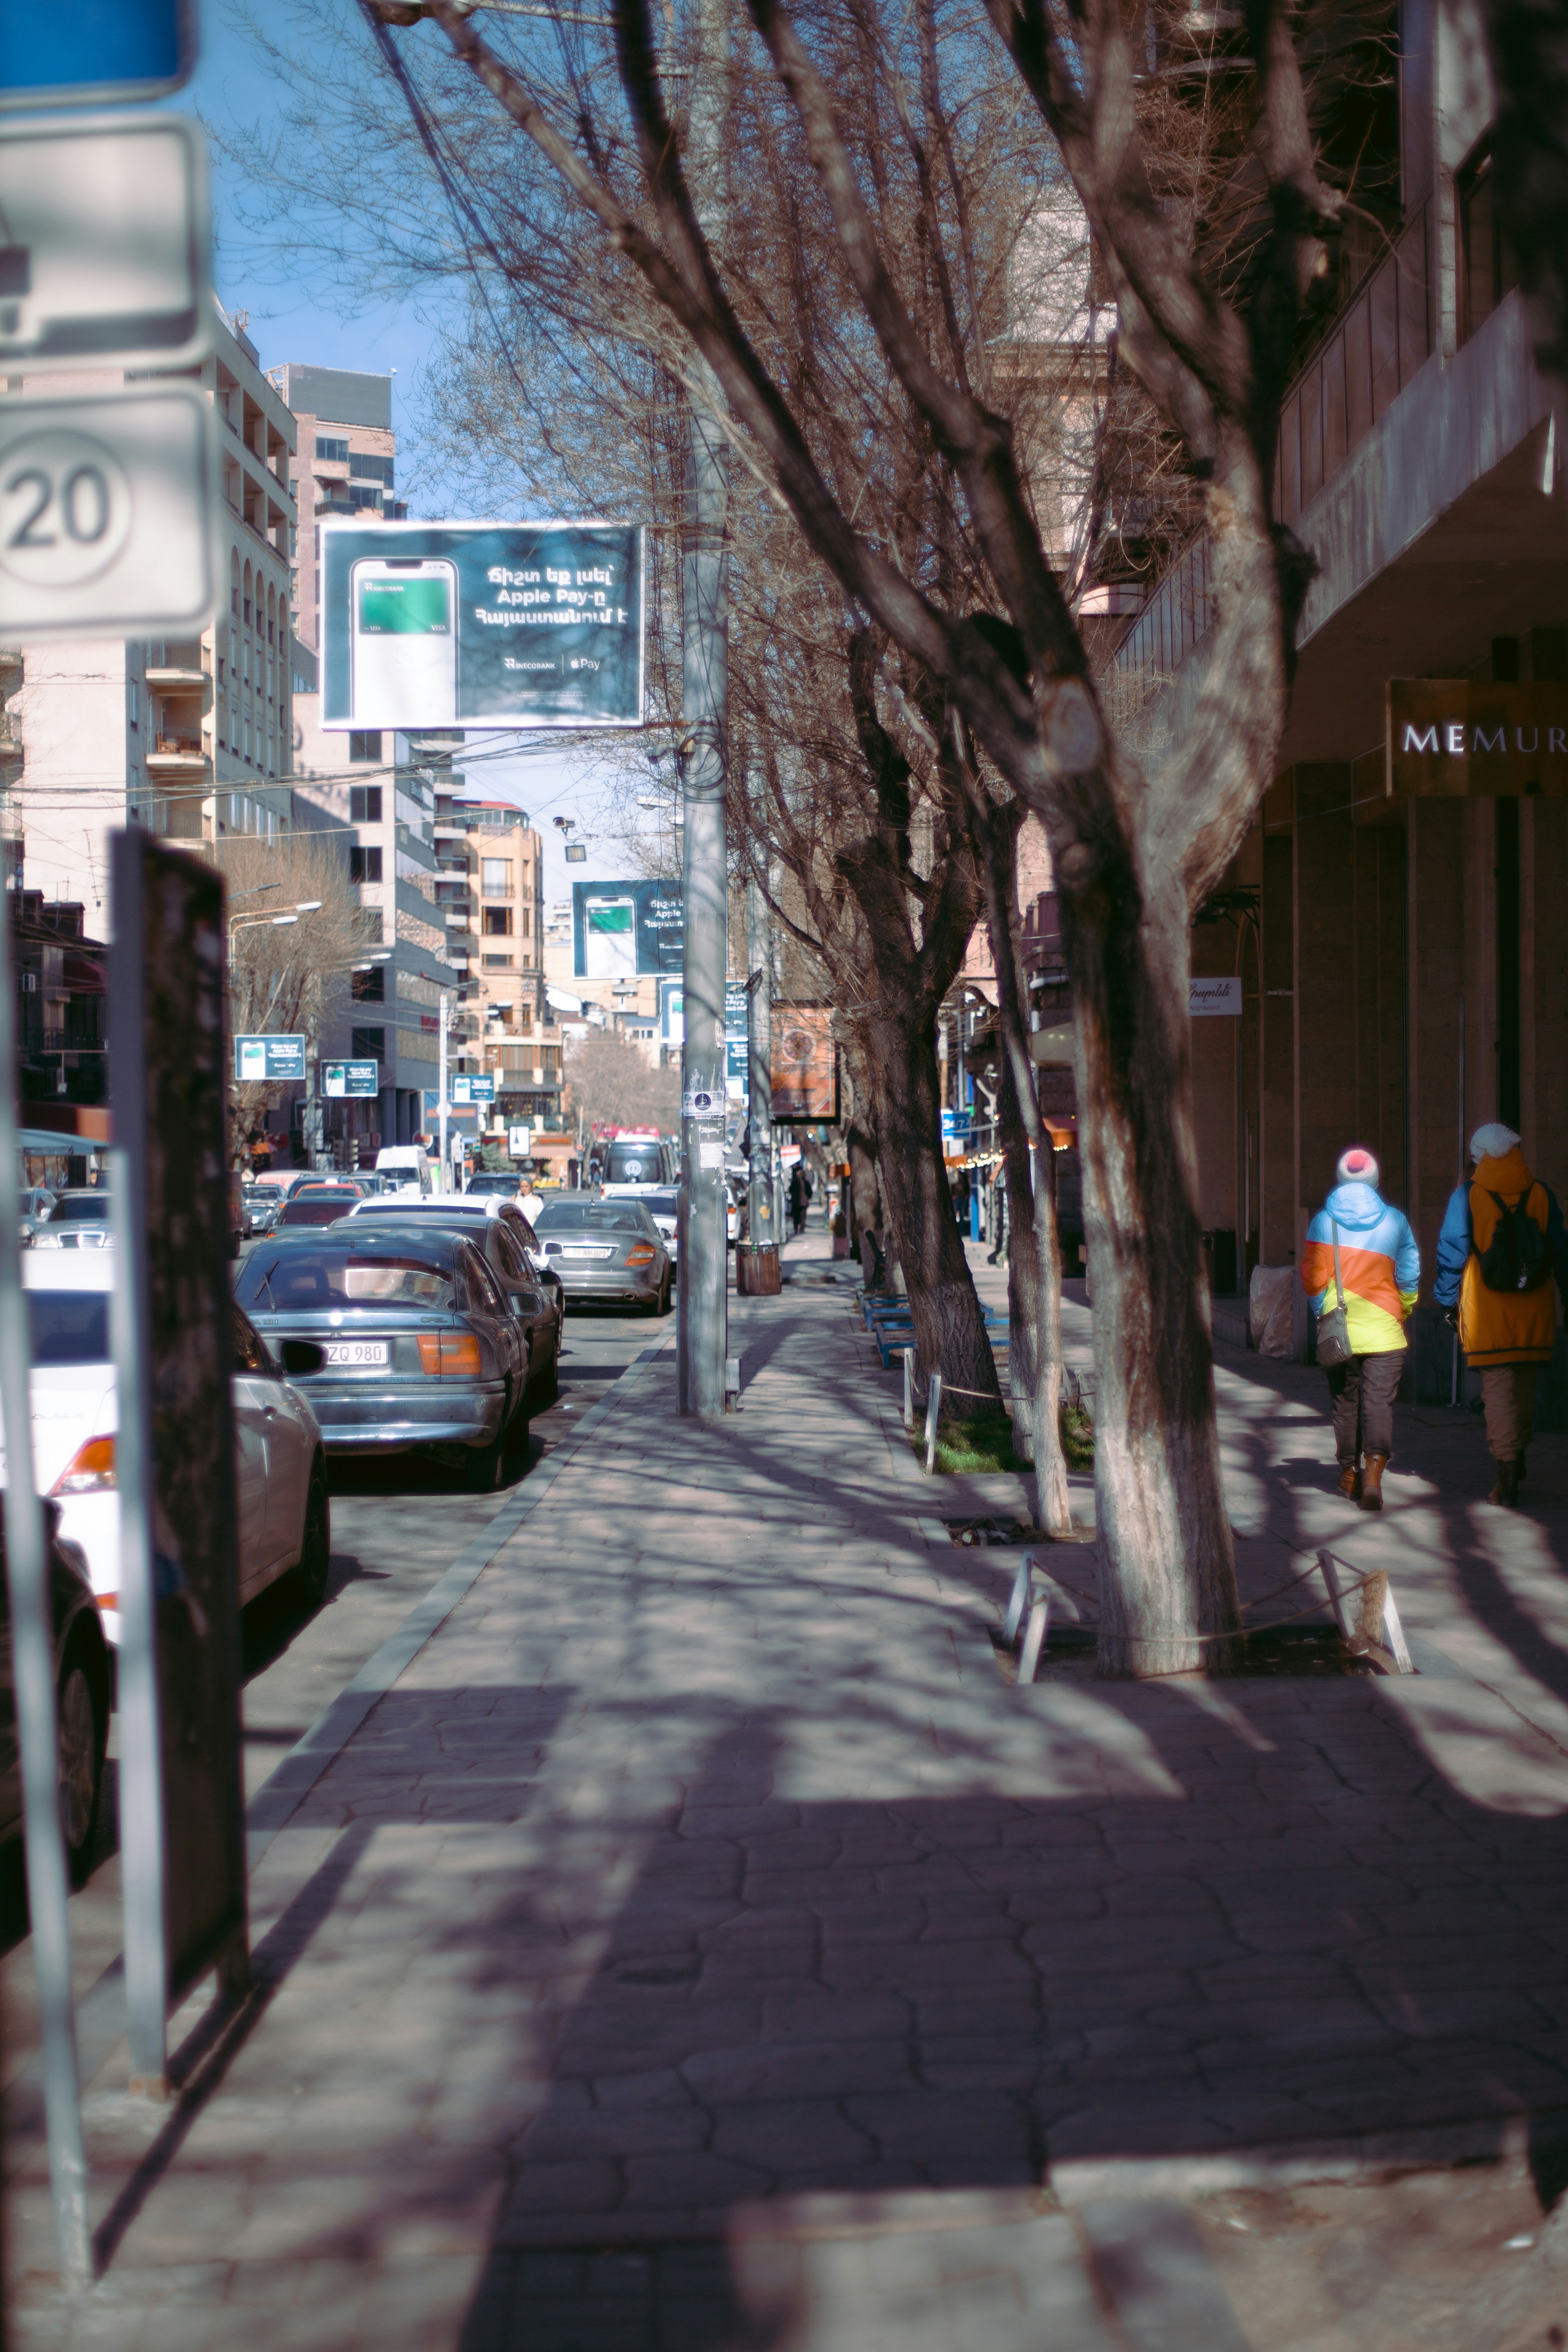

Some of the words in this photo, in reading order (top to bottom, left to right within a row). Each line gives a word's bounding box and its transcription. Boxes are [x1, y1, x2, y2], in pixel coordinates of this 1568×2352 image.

[5, 463, 109, 548] 20
[488, 567, 540, 586] Ճիշտ
[546, 567, 571, 586] եք
[497, 589, 551, 606] Apple
[556, 589, 605, 606] Pay-ը
[475, 609, 613, 627] Հայաստանում
[617, 609, 628, 624] է
[580, 658, 600, 671] Pay
[655, 909, 681, 919] Apple
[329, 1346, 349, 1361] ZQ
[355, 1346, 382, 1361] 980
